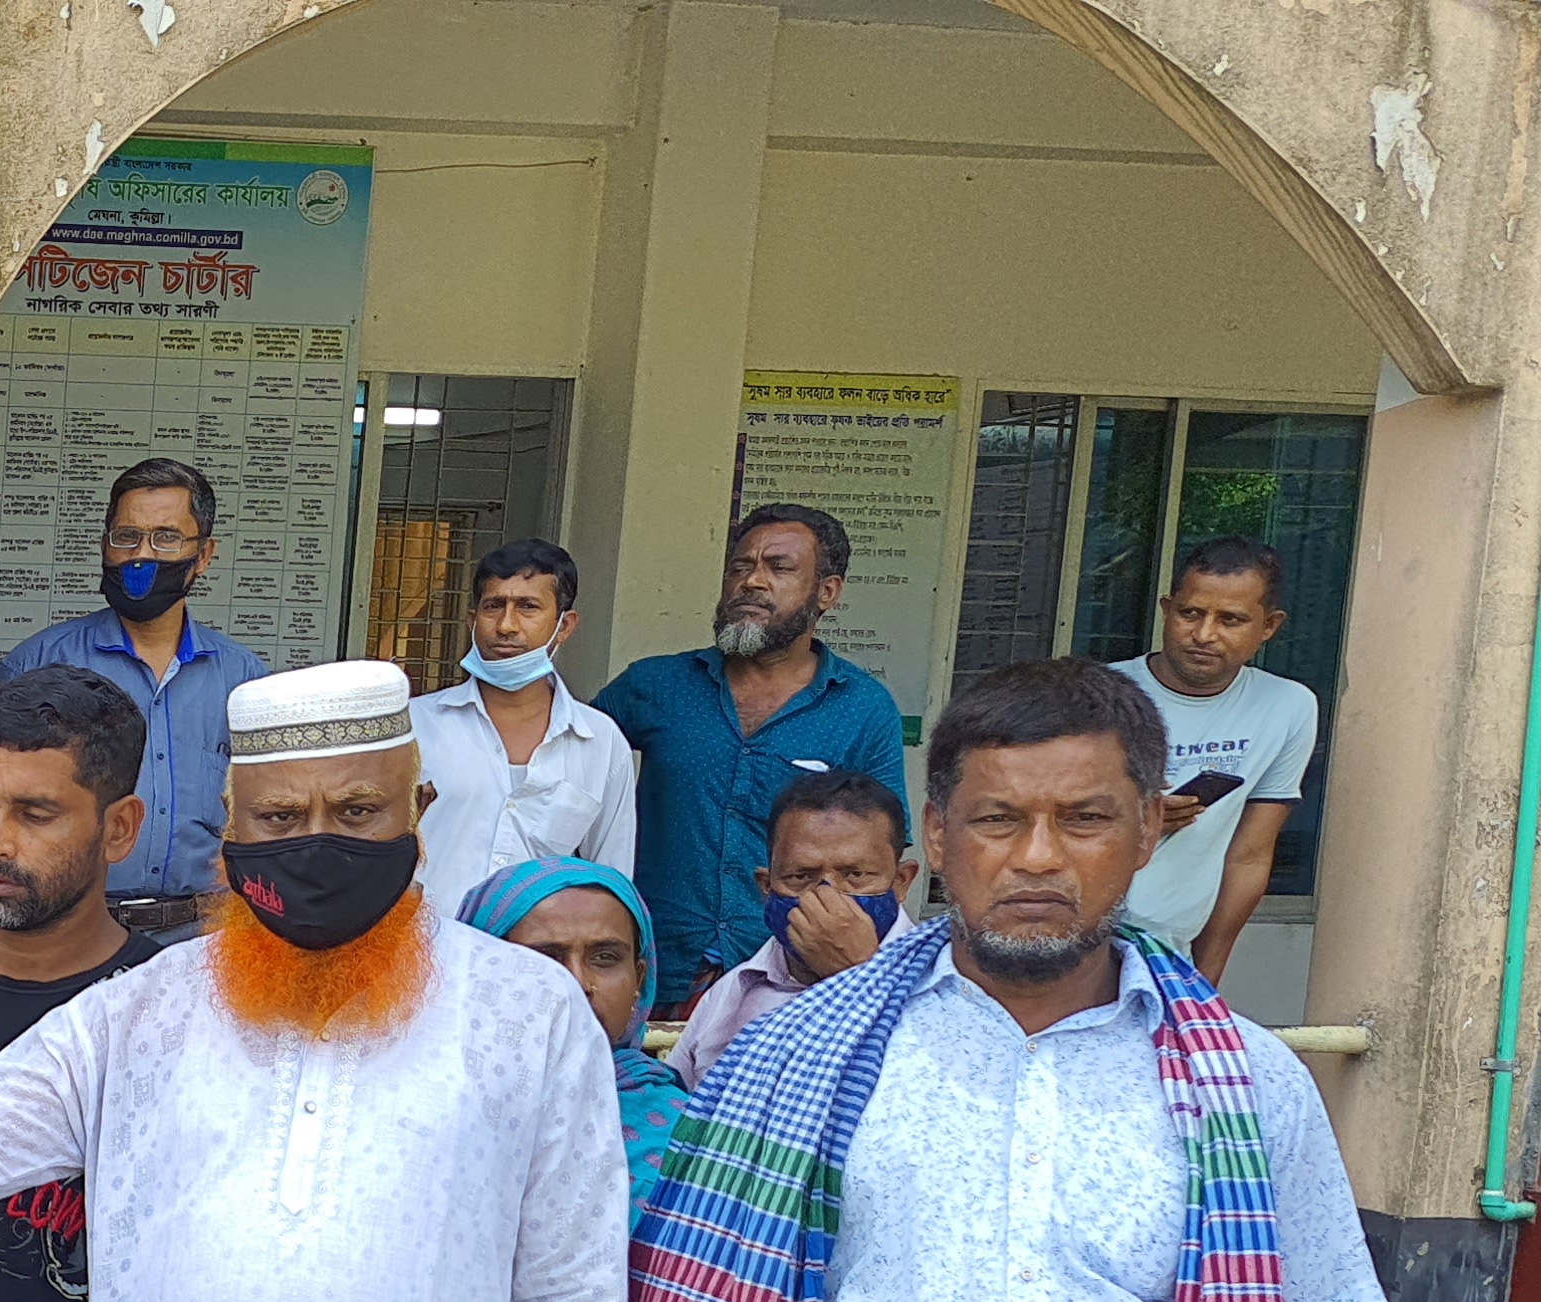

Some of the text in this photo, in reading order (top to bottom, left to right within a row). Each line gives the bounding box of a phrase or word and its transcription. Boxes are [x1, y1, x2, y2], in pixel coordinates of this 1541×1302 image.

[108, 172, 210, 204] অফিসারের
[216, 175, 292, 208] কার্যালয়
[88, 210, 125, 225] মেঘনা,
[15, 244, 259, 300] টিজেন চার্টার
[26, 295, 220, 319] নাগরিক সেবার তথ্য সারণী
[1168, 738, 1250, 756] twear
